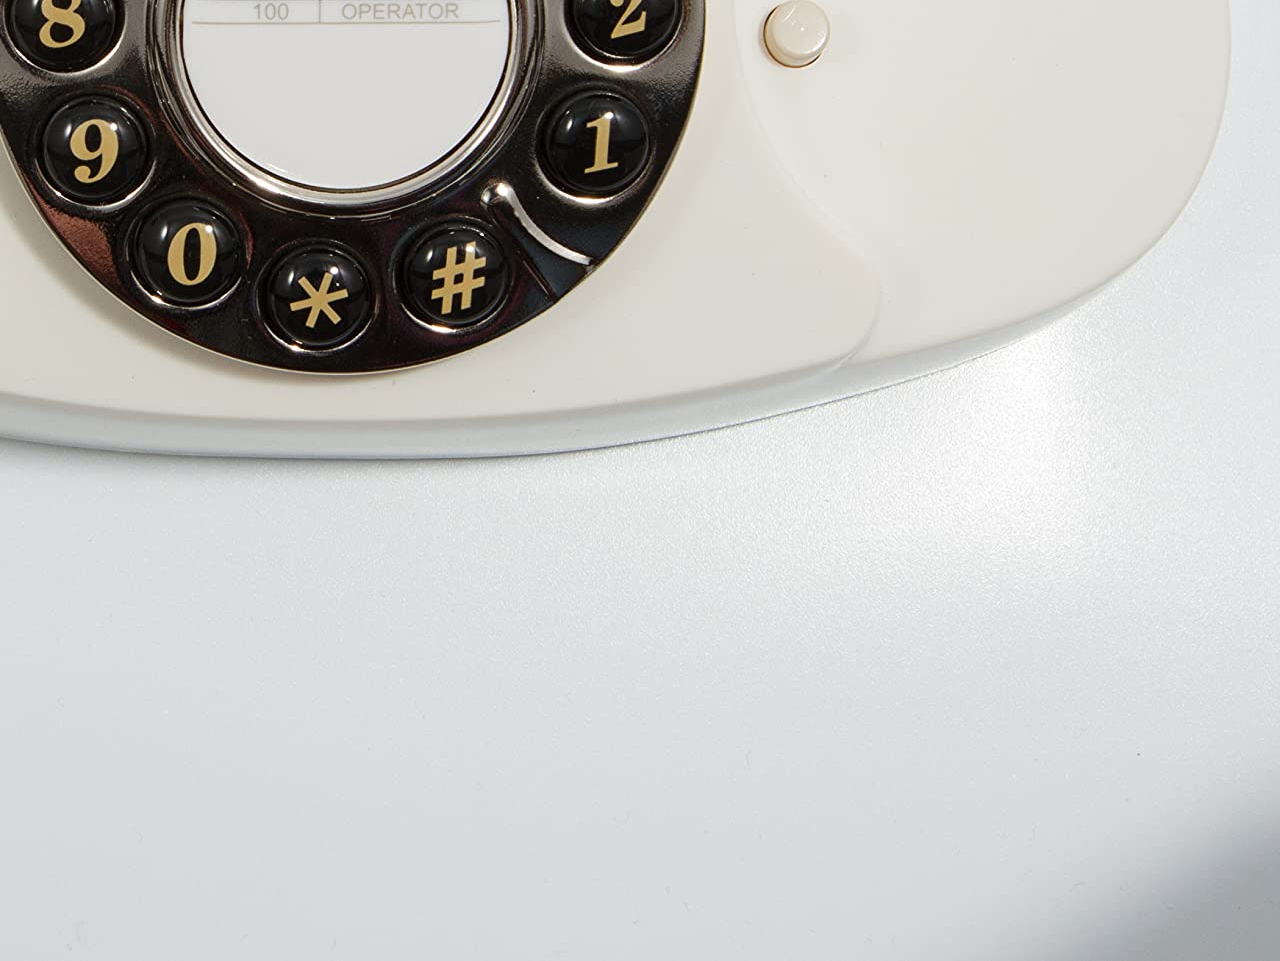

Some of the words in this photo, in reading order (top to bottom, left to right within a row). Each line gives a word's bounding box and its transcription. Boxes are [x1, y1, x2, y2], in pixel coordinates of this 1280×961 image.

[253, 3, 289, 21] 100
[341, 2, 460, 21] OPERATOR
[69, 118, 119, 184] 9
[584, 115, 619, 173] 1
[167, 222, 217, 286] 0
